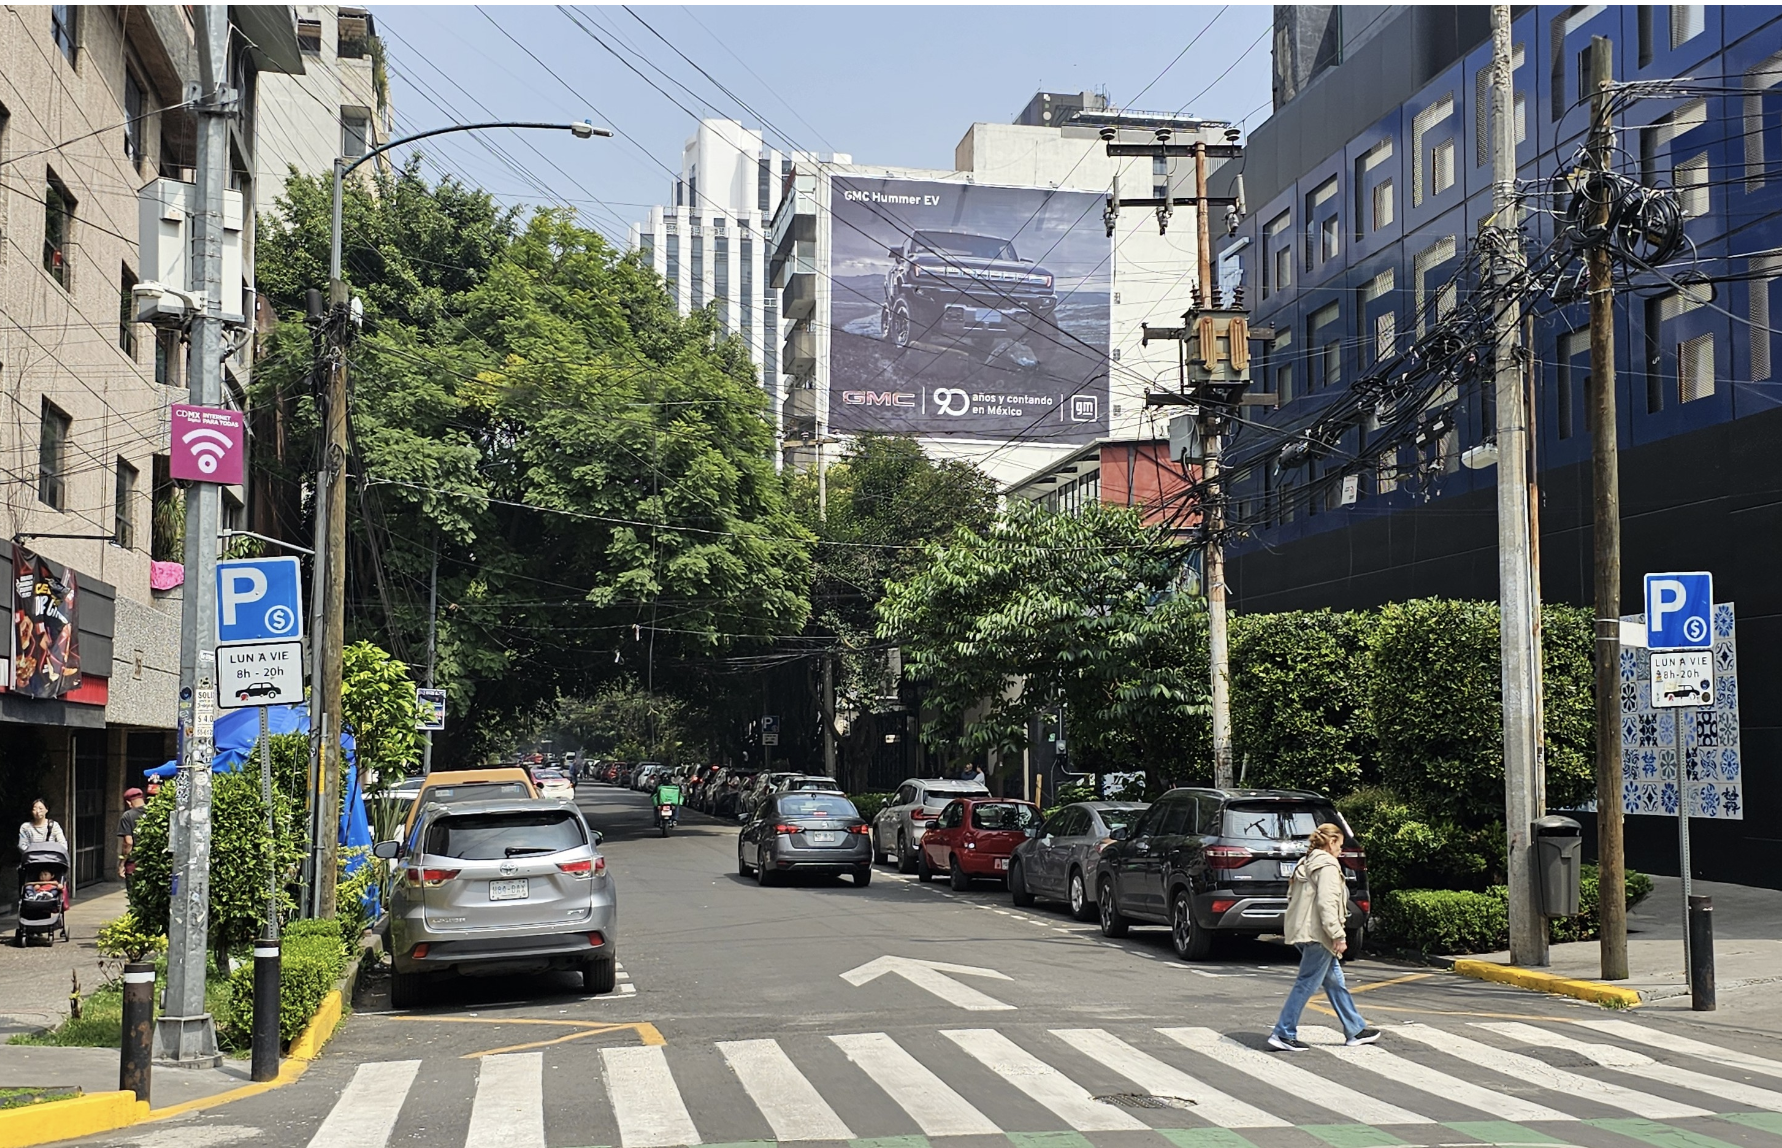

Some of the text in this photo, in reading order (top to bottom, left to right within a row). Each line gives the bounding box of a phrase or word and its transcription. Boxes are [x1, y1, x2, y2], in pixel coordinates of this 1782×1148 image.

[844, 190, 940, 206] GMC Hummer EV
[842, 390, 916, 407] GMC
[933, 387, 970, 416] 90
[972, 392, 1053, 406] años y contando
[175, 409, 200, 419] CDMX
[972, 404, 1023, 416] en México
[1075, 401, 1094, 416] gm
[202, 412, 232, 421] INTERNET
[202, 418, 239, 428] PARA TODAS
[221, 567, 268, 626] P
[1650, 579, 1687, 632] P
[230, 650, 289, 664] LUN A VIE
[1655, 656, 1708, 667] LUN A VIE
[236, 667, 251, 679] 8h
[263, 666, 284, 677] 20h
